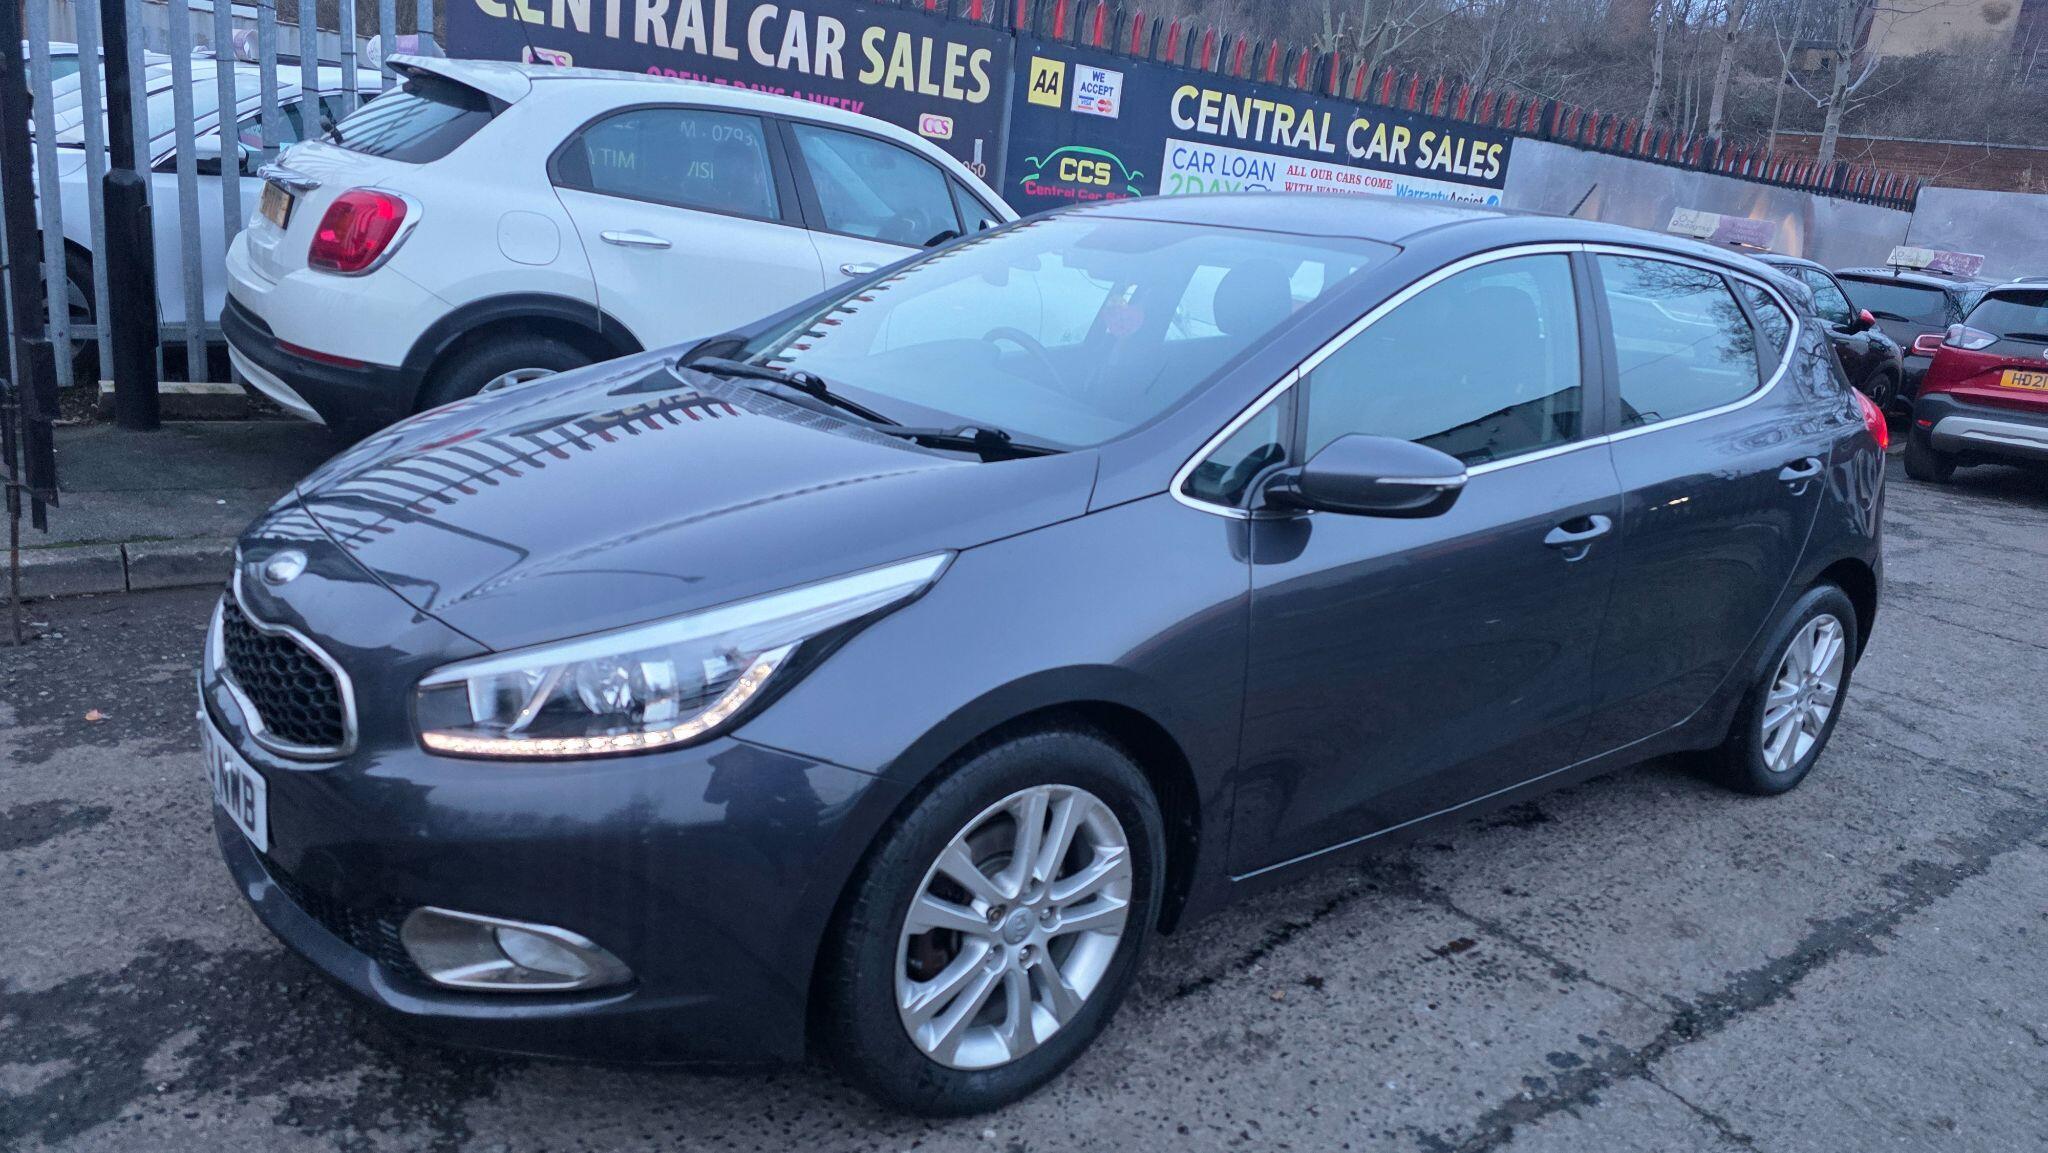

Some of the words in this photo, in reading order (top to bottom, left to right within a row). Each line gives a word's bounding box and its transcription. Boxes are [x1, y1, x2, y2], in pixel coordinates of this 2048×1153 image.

[474, 0, 739, 61] TRAL
[747, 3, 844, 80] CAR
[858, 26, 992, 103] SALES
[1033, 69, 1059, 95] AA
[1080, 81, 1115, 97] ACCEPT
[1092, 70, 1106, 83] WE
[1170, 84, 1336, 153] CENTRAL
[1346, 118, 1412, 165] CAR
[1415, 130, 1503, 180] SALES
[1059, 157, 1111, 186] CCS
[1172, 147, 1215, 174] CAR
[1221, 154, 1276, 182] LOAN
[1286, 164, 1307, 178] ALL
[1310, 168, 1333, 181] OUR
[1335, 171, 1362, 186] CARS
[1364, 175, 1394, 190] COME
[1025, 180, 1076, 198] Central
[1077, 188, 1102, 200] Car
[1284, 181, 1313, 193] WITH
